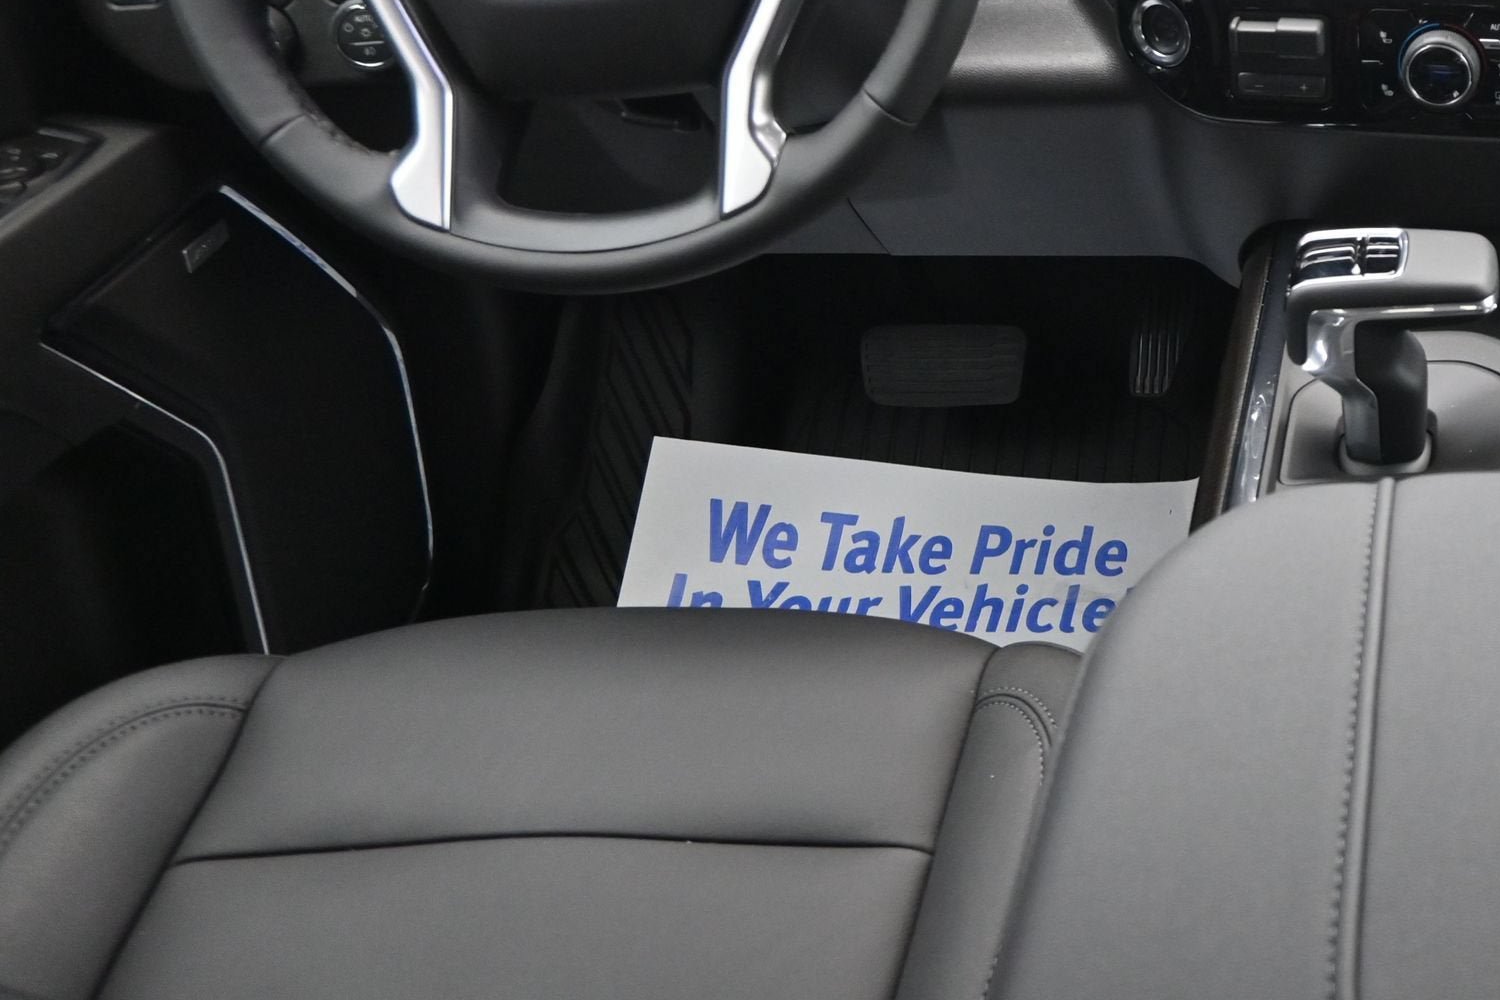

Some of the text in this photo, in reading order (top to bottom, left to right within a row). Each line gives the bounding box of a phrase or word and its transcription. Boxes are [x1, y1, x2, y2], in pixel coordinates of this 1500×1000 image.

[709, 497, 1128, 577] We Take Pride
[900, 583, 1137, 634] Vehicle
